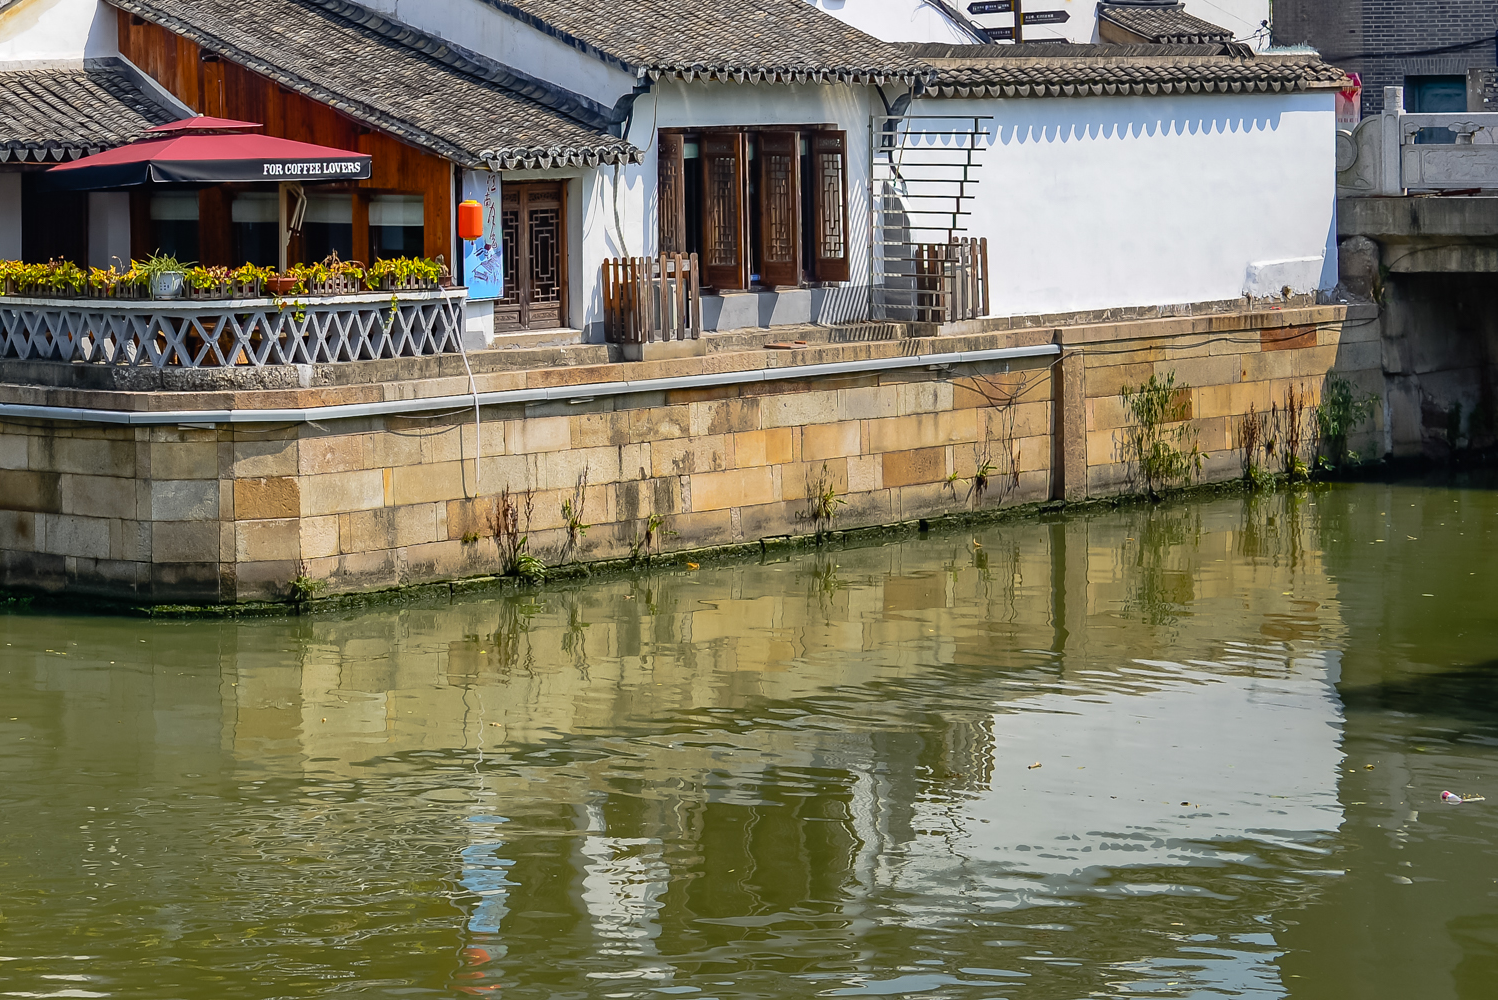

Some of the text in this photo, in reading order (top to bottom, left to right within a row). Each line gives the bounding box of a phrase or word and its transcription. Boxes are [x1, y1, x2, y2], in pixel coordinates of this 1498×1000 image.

[263, 162, 361, 175] FOR COFFEE LOVERS
